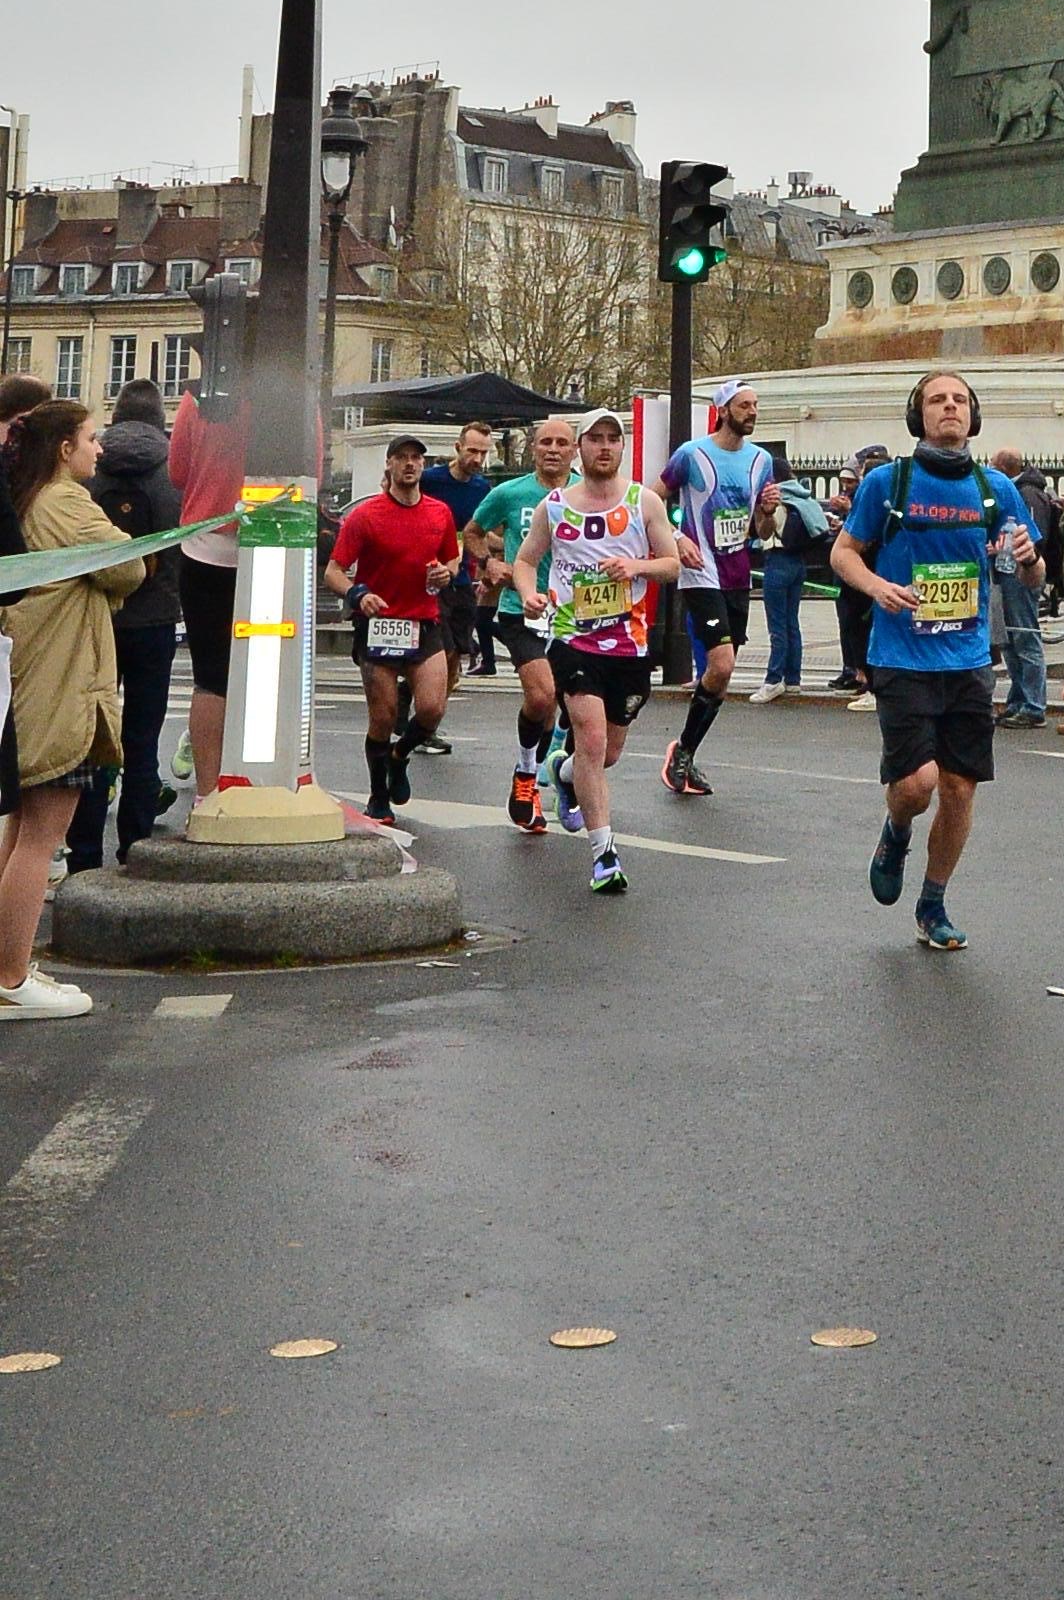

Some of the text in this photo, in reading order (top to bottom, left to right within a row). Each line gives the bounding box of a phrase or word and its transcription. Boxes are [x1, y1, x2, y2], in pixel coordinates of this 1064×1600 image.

[583, 584, 618, 605] 4247
[919, 581, 969, 604] 22923
[373, 620, 411, 637] 56556
